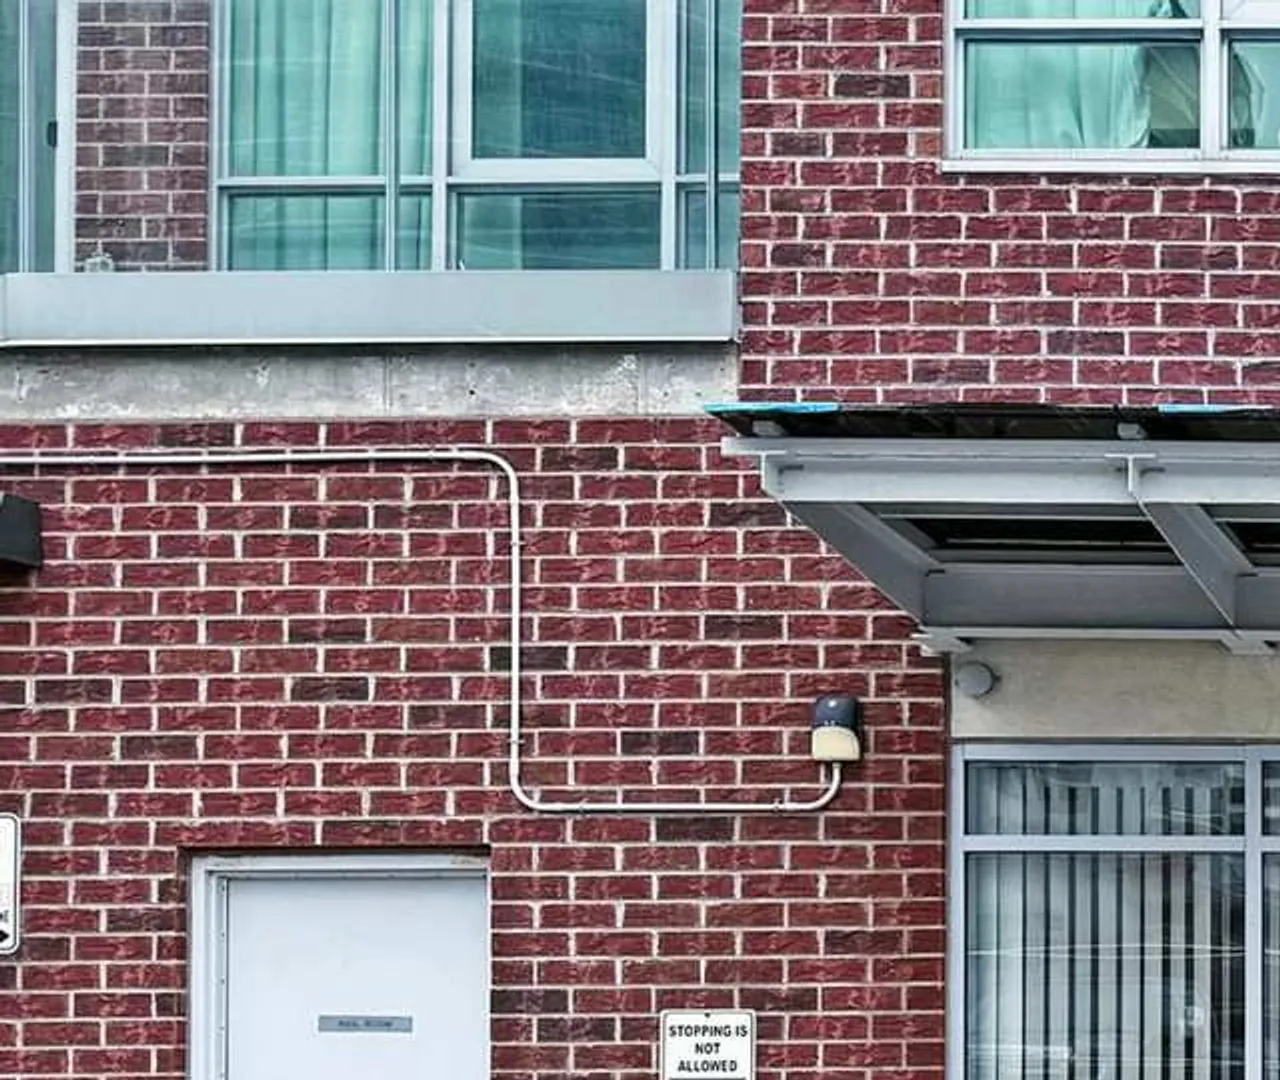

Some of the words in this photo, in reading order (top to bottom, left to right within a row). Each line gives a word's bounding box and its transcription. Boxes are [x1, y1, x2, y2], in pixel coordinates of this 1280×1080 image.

[668, 1025, 732, 1037] STOPPING
[736, 1025, 748, 1037] IS
[695, 1042, 721, 1054] NOT
[677, 1060, 738, 1072] ALLOWED
